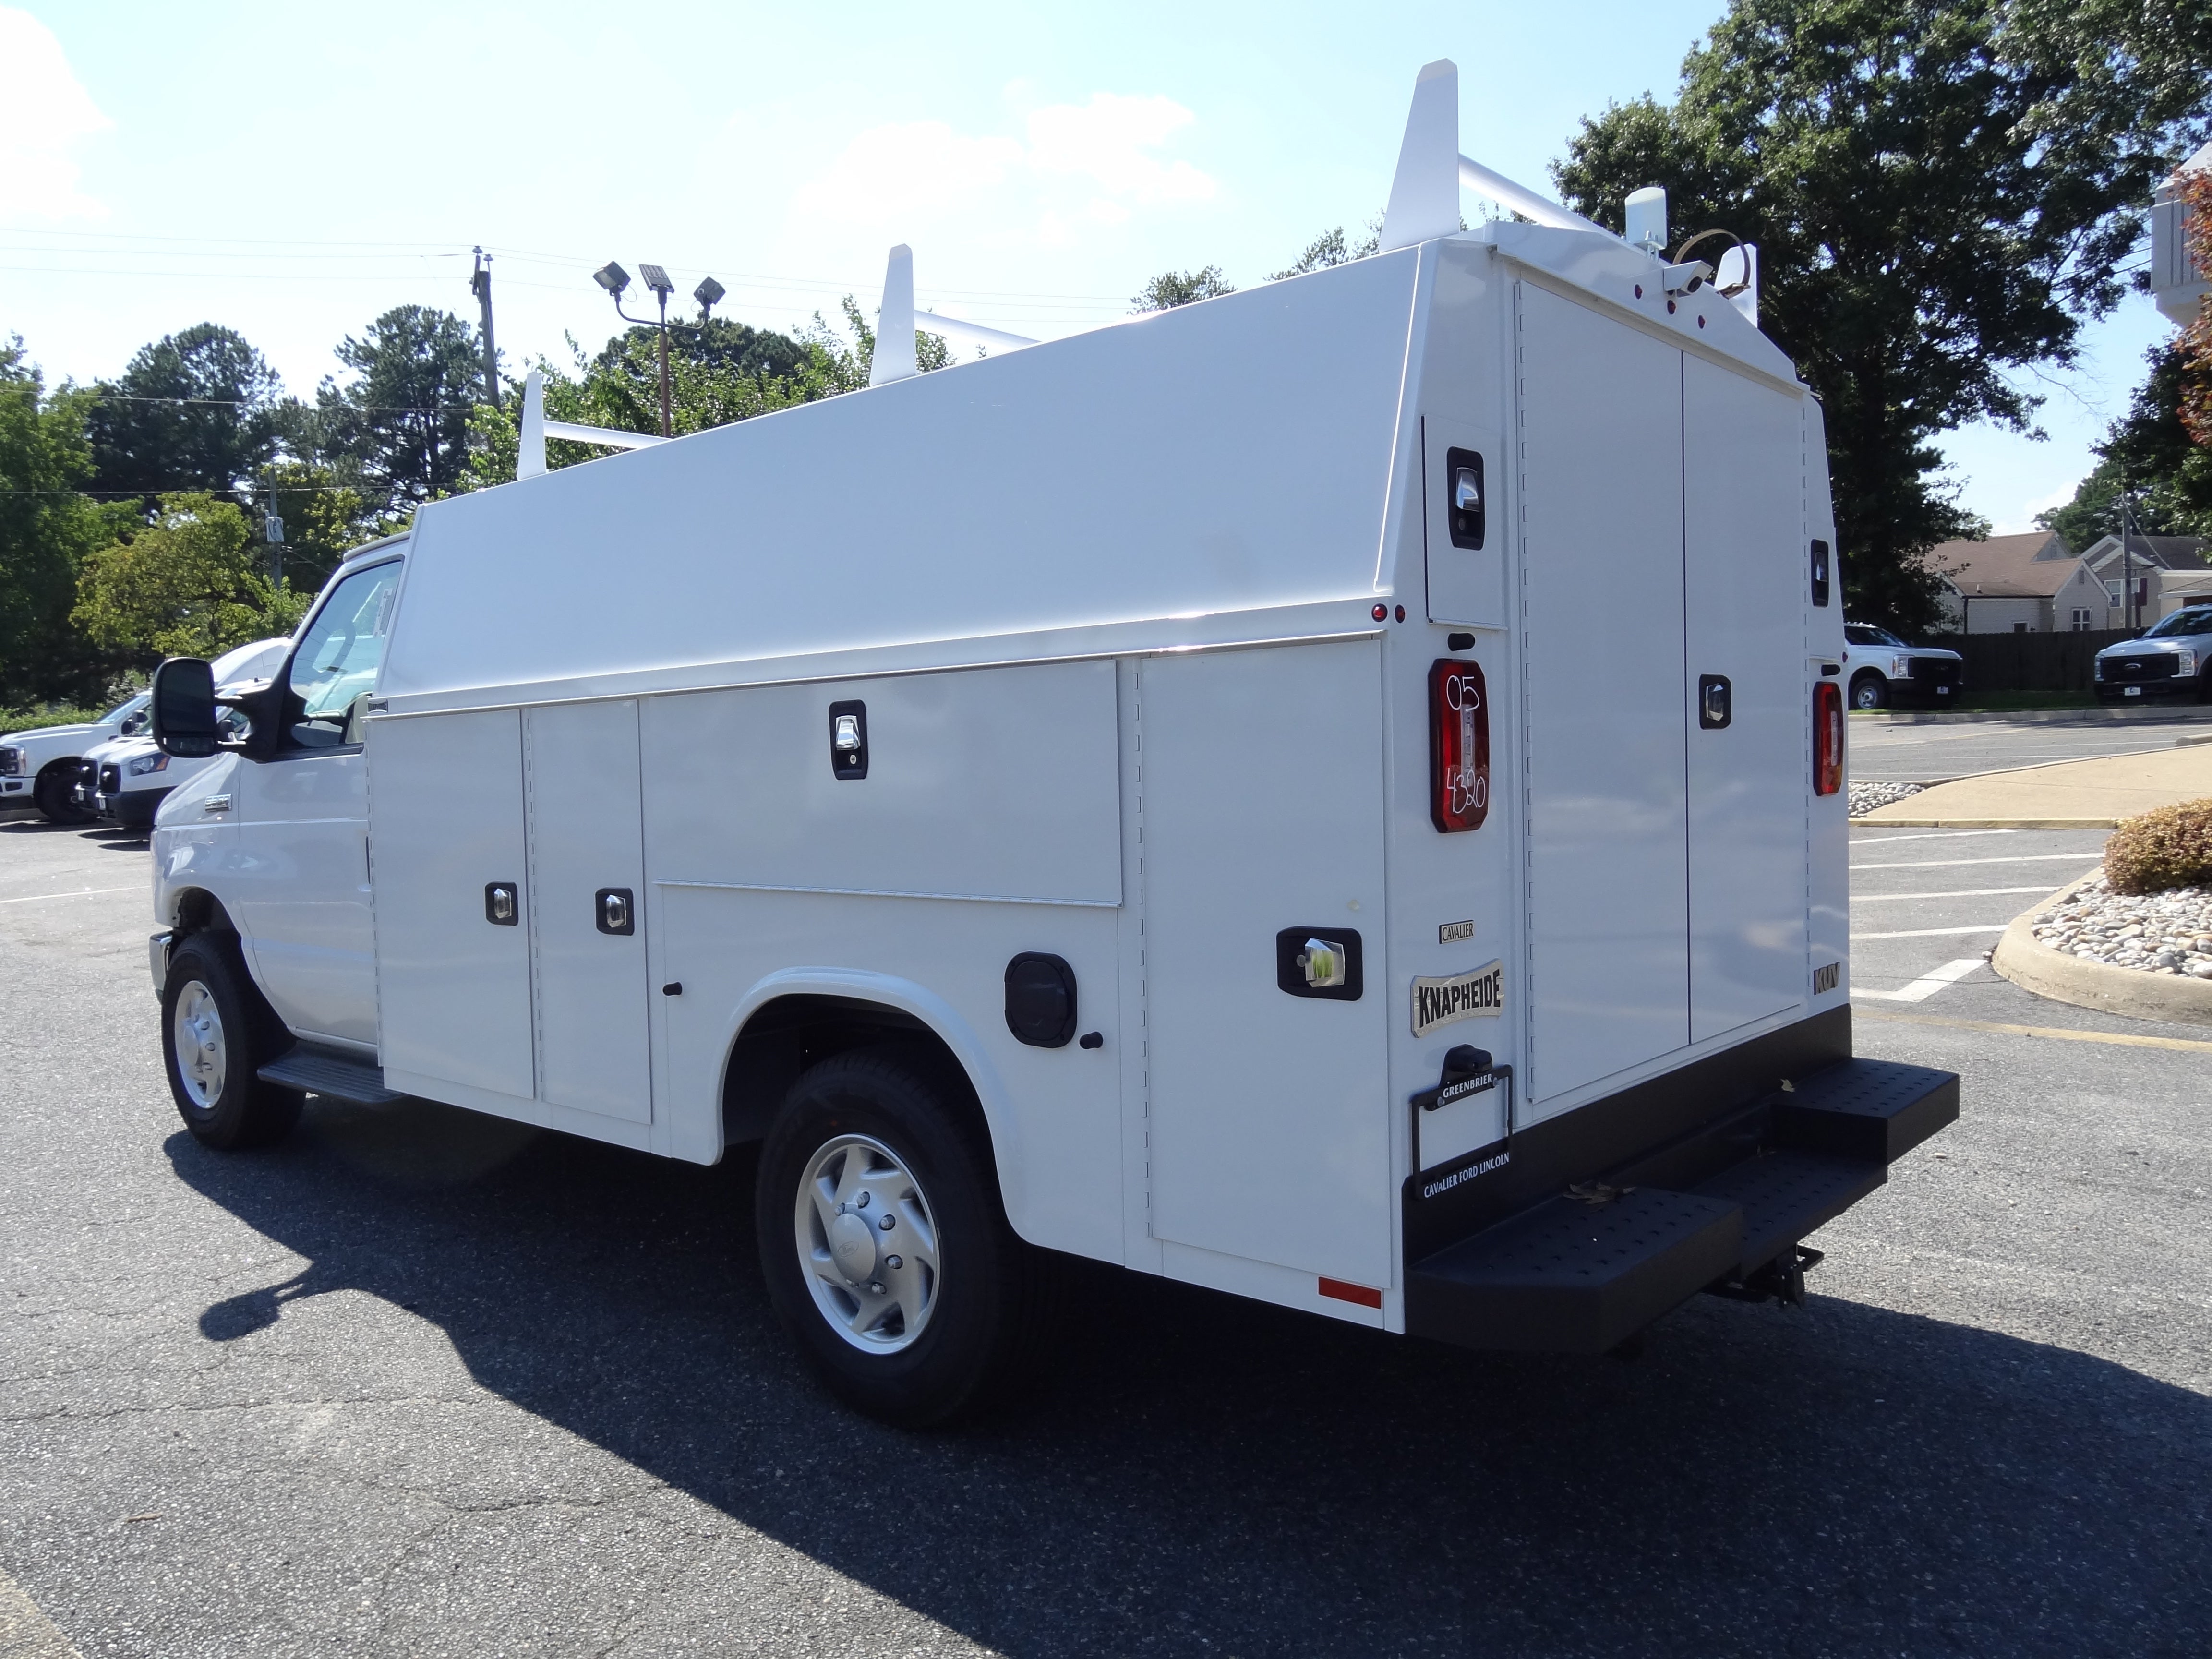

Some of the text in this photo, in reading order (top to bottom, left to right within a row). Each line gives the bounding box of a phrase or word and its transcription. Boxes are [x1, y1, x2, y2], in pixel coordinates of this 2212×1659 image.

[1446, 675, 1479, 711] 05
[1442, 923, 1474, 941] CAVALIER
[1814, 962, 1841, 996] KUV
[1419, 968, 1501, 1028] KNAPHEIDE
[1443, 1073, 1493, 1098] GREENBRIER
[1424, 1152, 1510, 1198] CAVALIER FORD LINCOLN
